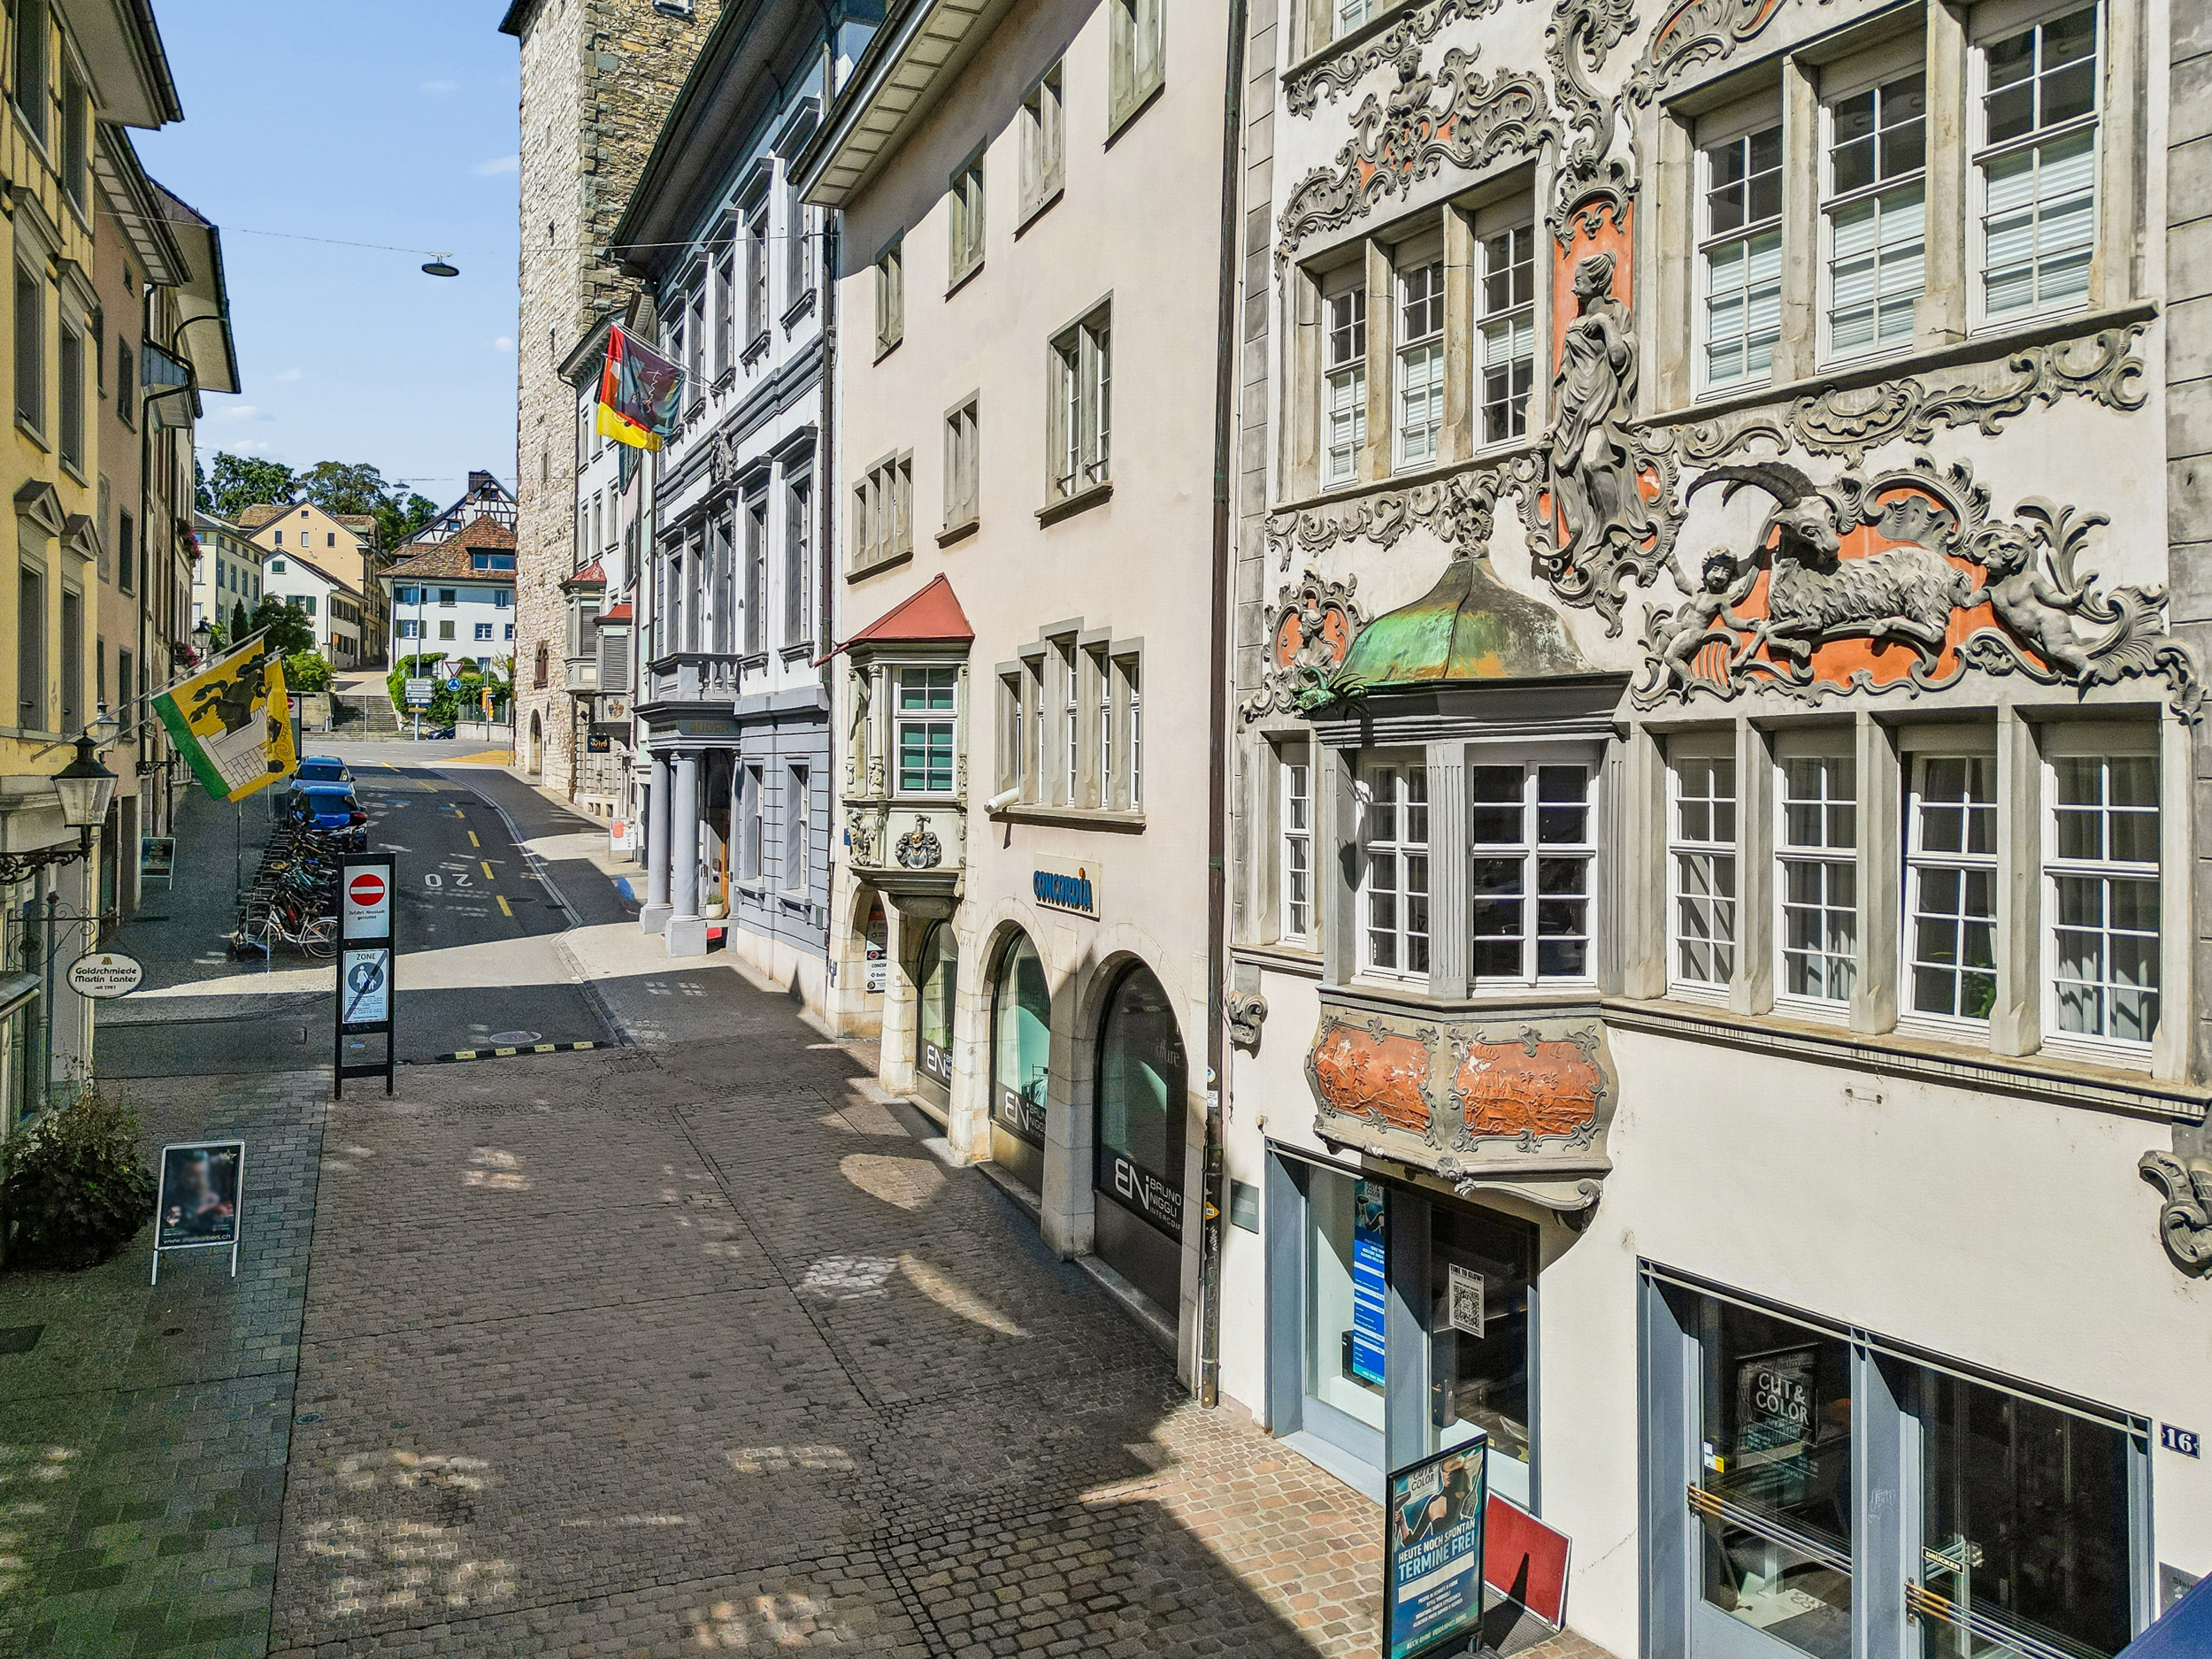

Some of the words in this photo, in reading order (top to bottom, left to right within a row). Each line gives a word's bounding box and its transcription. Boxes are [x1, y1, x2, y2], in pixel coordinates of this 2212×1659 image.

[1149, 1191, 1177, 1217] NIGGLI
[1150, 1178, 1182, 1206] BRUNO
[1450, 1264, 1461, 1275] TIME
[1462, 1268, 1468, 1277] TO
[1755, 1390, 1809, 1425] COLOR
[2166, 1427, 2193, 1453] 16
[1411, 1473, 1435, 1492] COLOR
[1398, 1544, 1422, 1564] HEUTE
[1423, 1534, 1443, 1553] NOCH
[1444, 1518, 1476, 1542] SPONTAN
[1398, 1542, 1449, 1582] TERMINE
[1451, 1529, 1475, 1556] FREI
